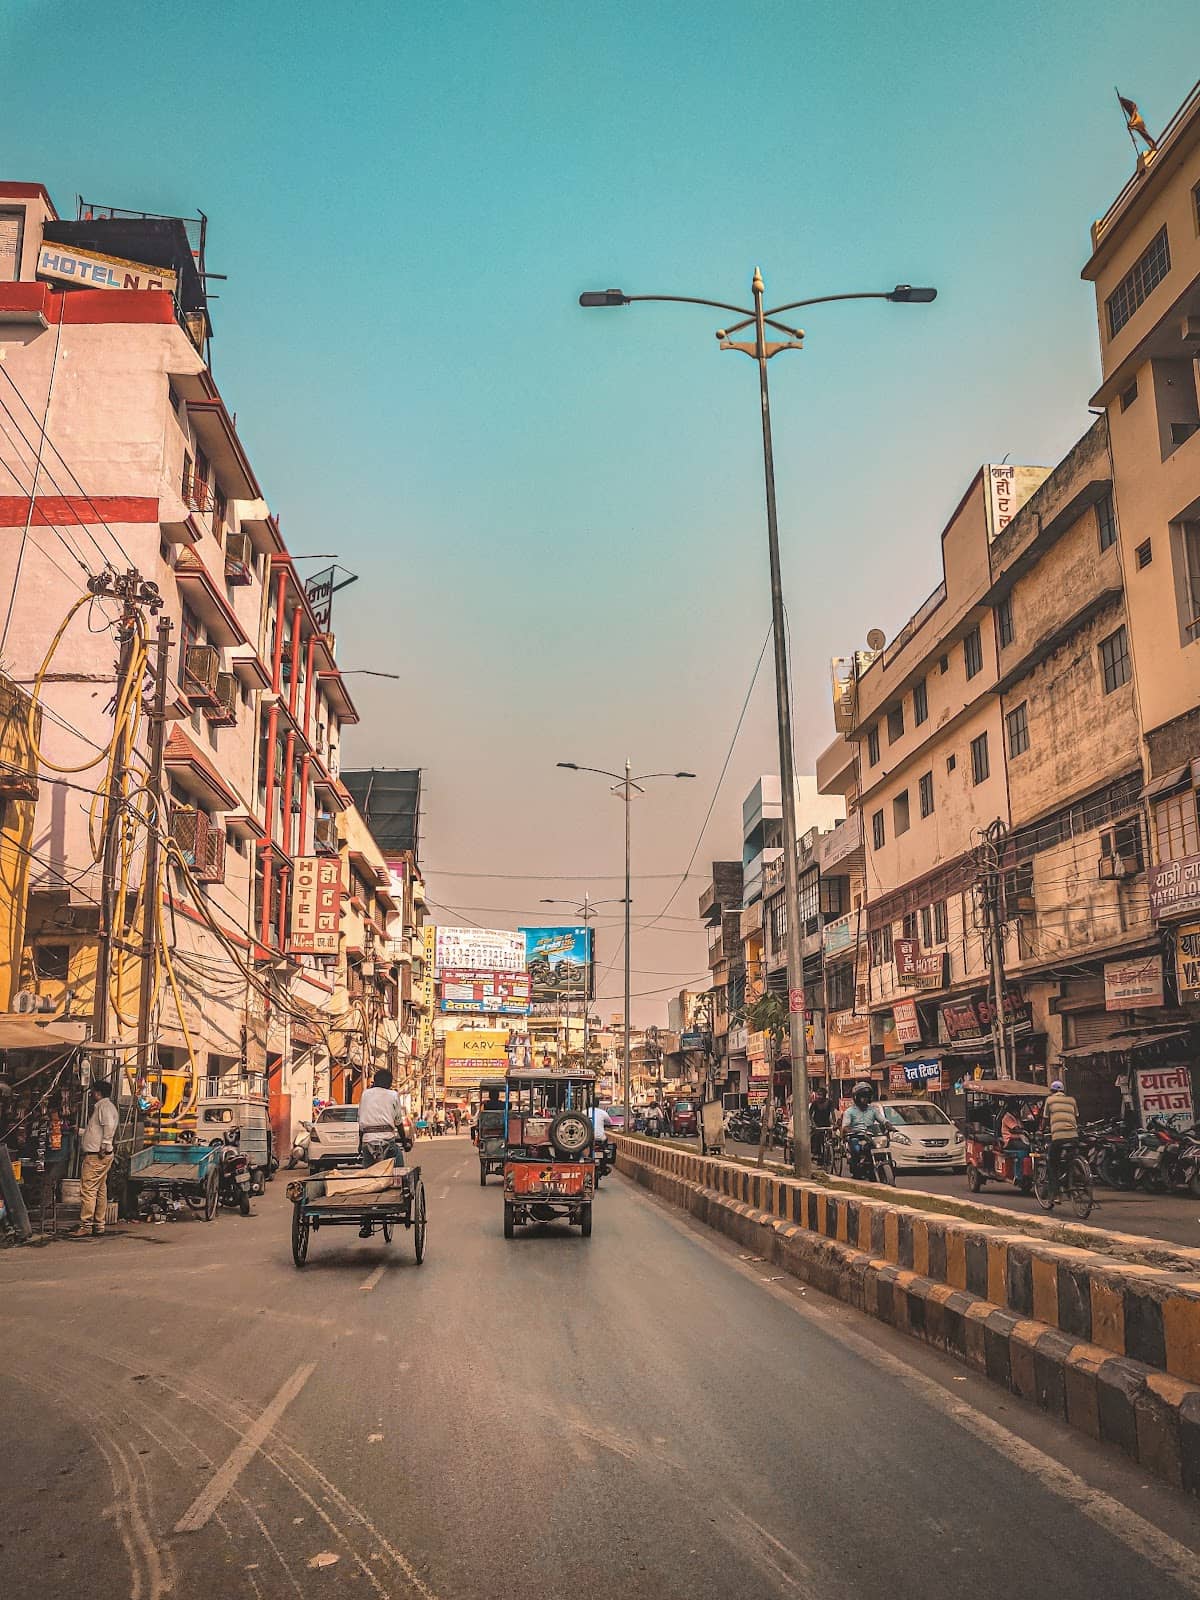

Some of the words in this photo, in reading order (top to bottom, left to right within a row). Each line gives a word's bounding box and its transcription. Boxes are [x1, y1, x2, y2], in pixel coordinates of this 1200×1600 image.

[42, 252, 120, 287] HOTEL
[1156, 862, 1181, 888] यात्री
[298, 861, 313, 929] HOTEL
[318, 861, 338, 930] होटल
[1151, 886, 1179, 907] YATRI
[916, 956, 942, 974] HOTEL
[904, 1066, 918, 1080] रेल
[918, 1063, 939, 1078] टिकट
